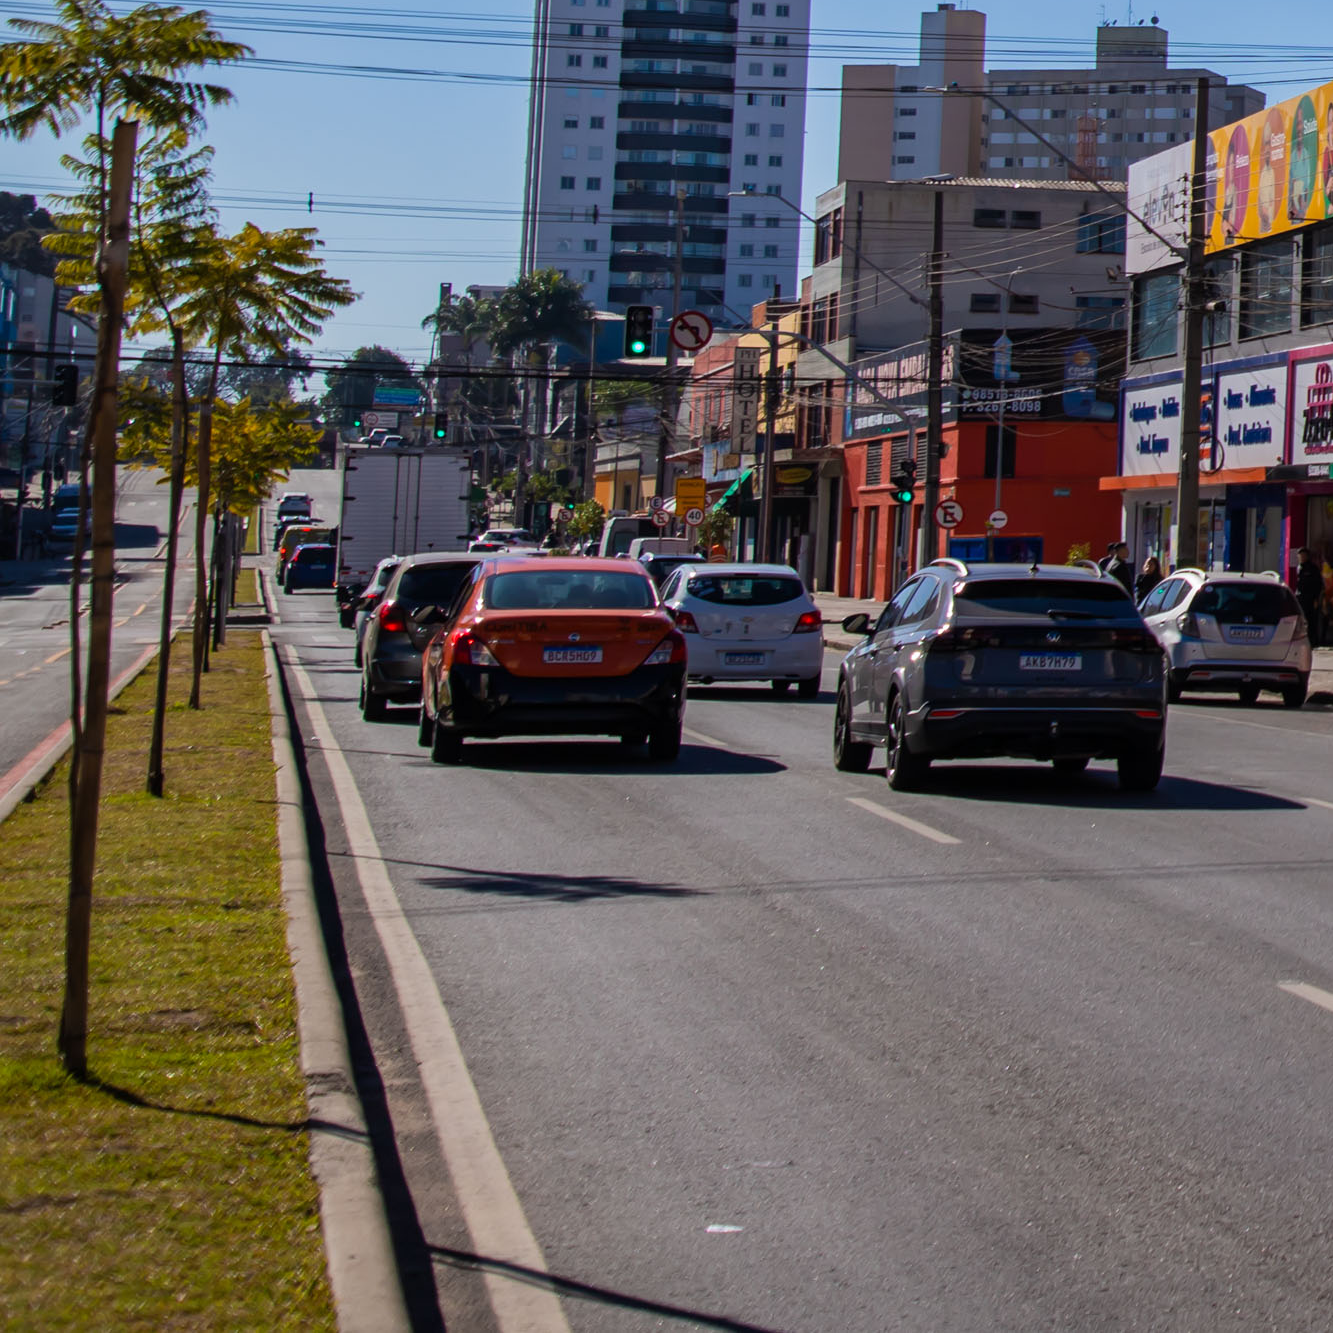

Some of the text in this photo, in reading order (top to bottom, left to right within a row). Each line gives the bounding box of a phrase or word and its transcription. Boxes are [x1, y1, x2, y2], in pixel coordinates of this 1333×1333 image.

[738, 364, 756, 453] HOTEL
[688, 510, 702, 521] 40
[547, 651, 597, 662] BCR5H09
[1025, 657, 1076, 668] AKB7H79
